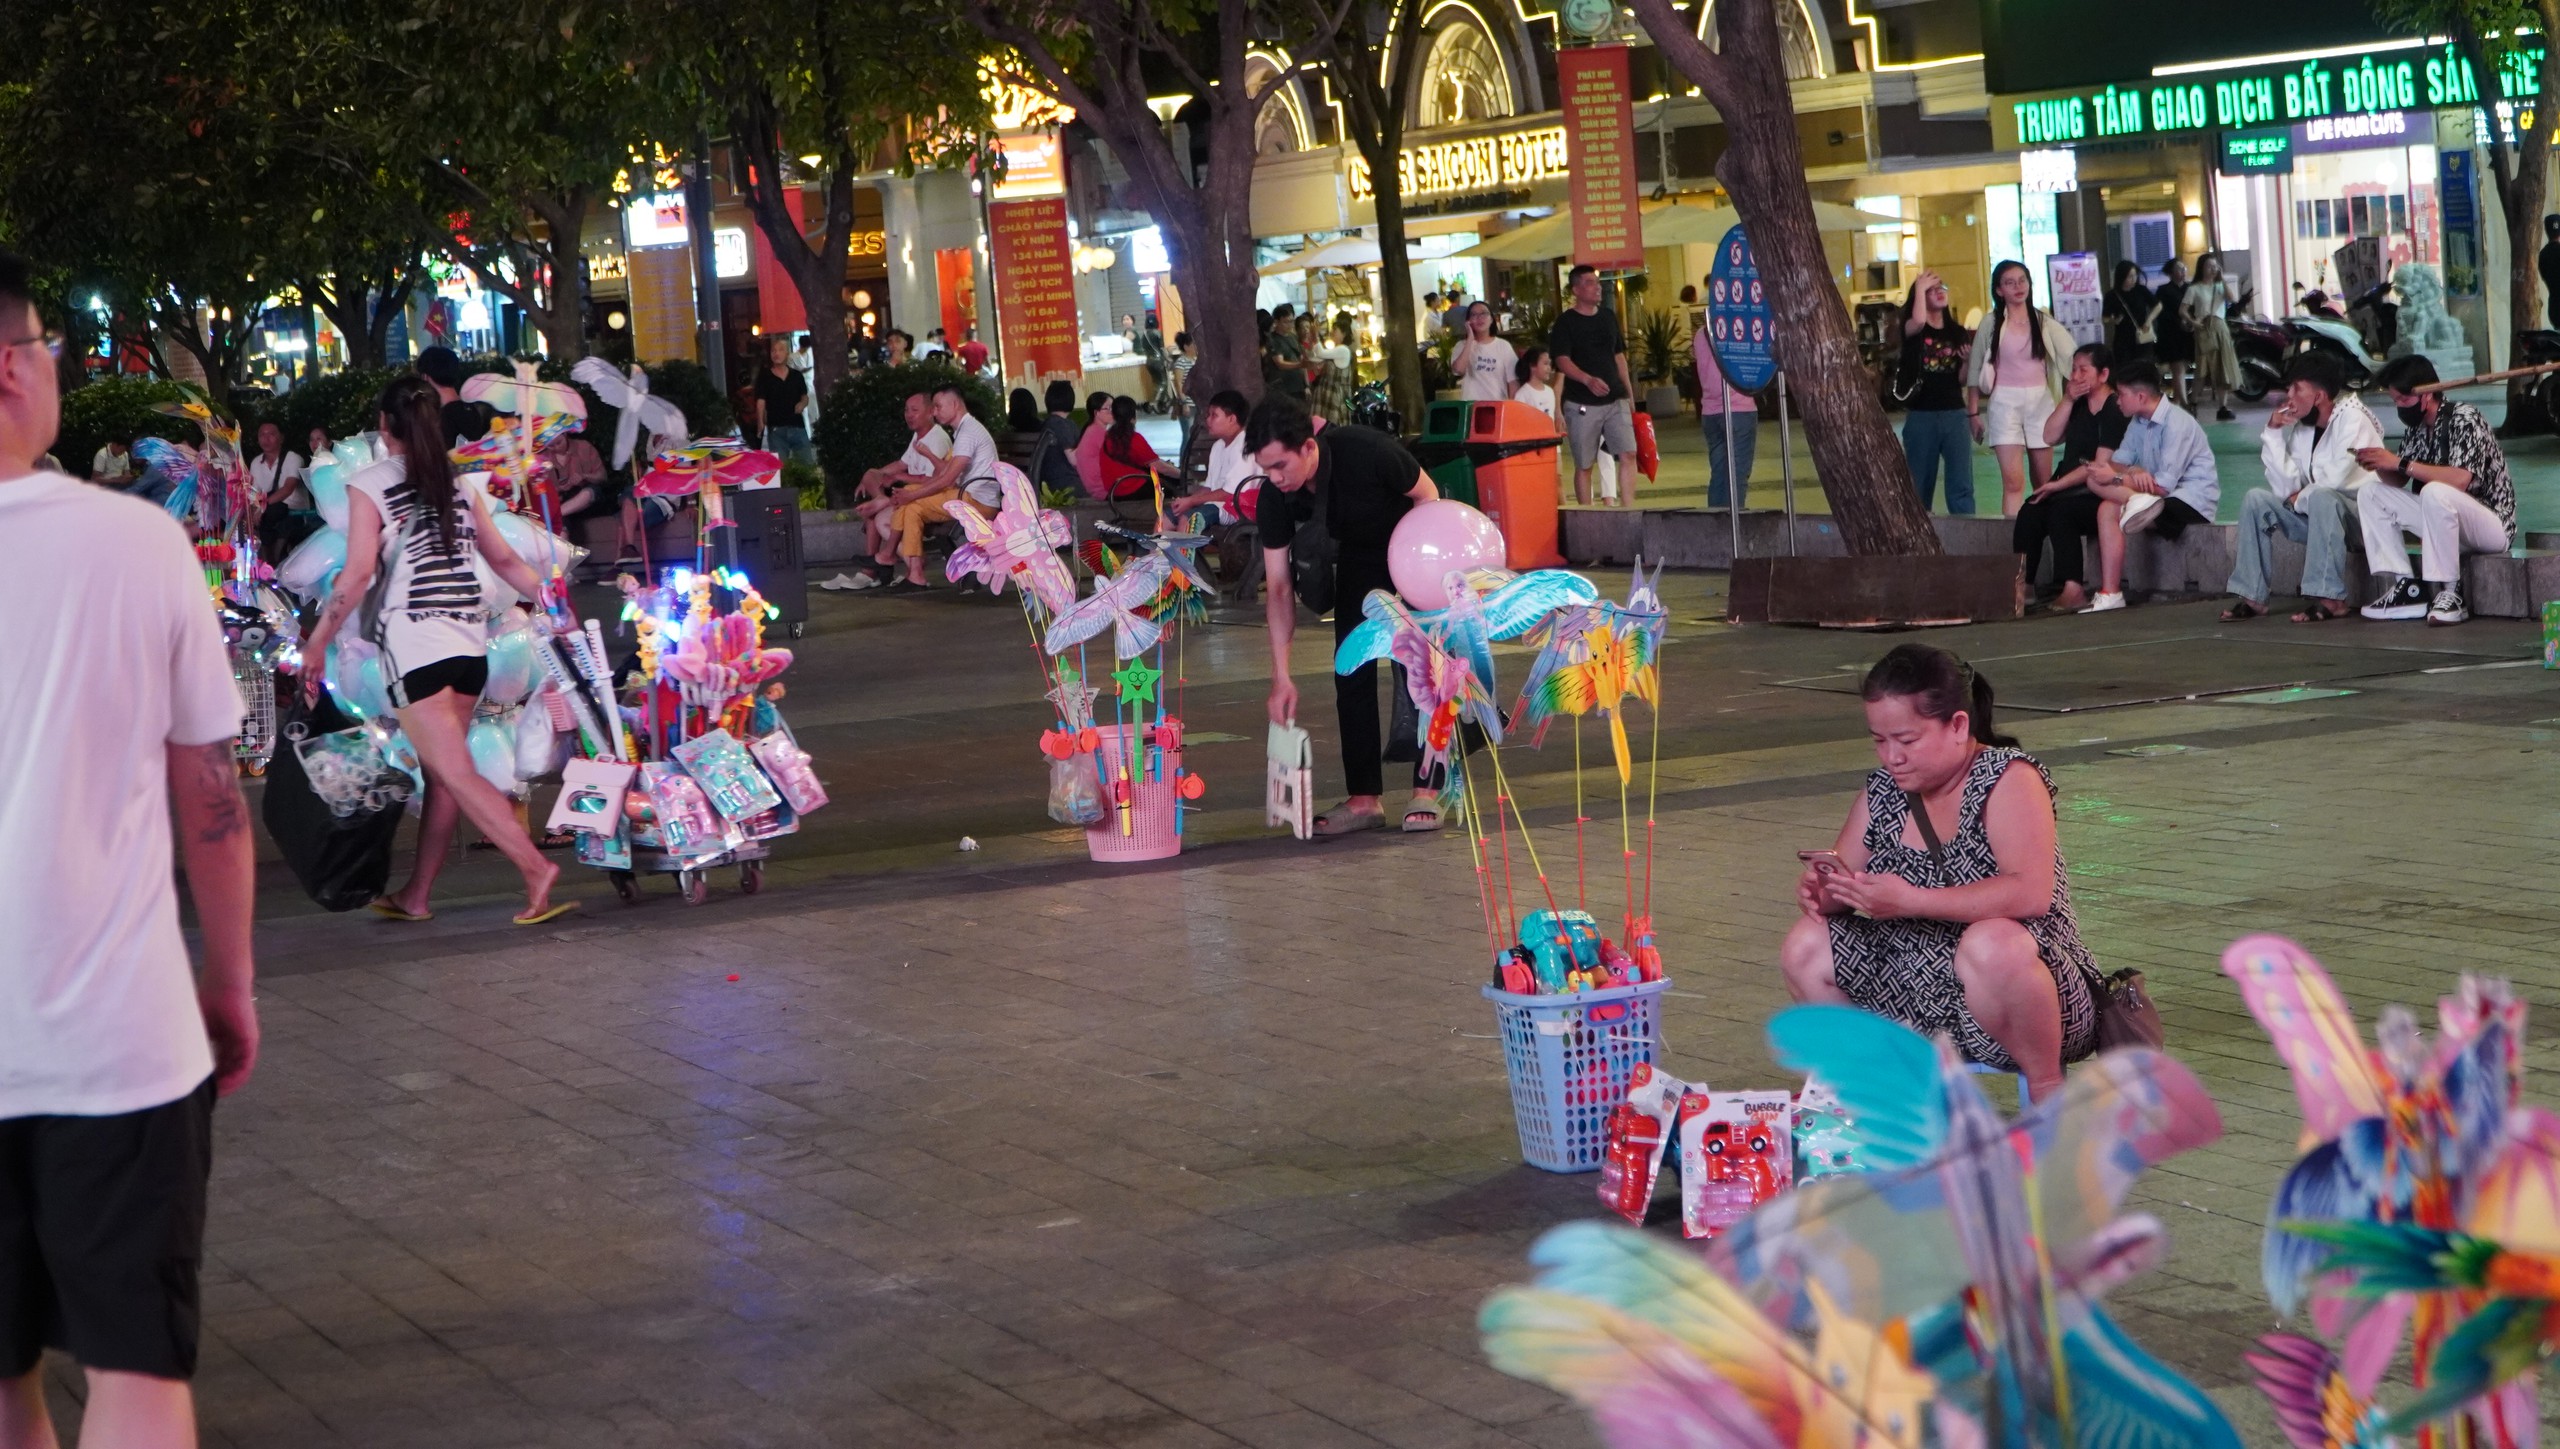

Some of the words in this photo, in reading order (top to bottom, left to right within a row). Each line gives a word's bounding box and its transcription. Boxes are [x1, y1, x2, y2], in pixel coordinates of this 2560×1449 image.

[2014, 96, 2085, 144] TRUNG
[2093, 84, 2142, 136] TÂM
[2151, 85, 2206, 130] GIAO
[2216, 77, 2274, 129] DỊCH
[2284, 59, 2331, 118] BẤT
[2343, 56, 2416, 116] ĐỘNG
[2307, 119, 2334, 141] LIFE
[2334, 115, 2369, 138] FOUR
[2370, 112, 2405, 135] CUTS
[2229, 139, 2258, 154] ZONE
[2259, 137, 2286, 152] GOLF
[1418, 137, 1499, 194] SAIGON
[1500, 126, 1569, 183] HOTEL
[1005, 207, 1035, 218] NHIỆT
[1038, 206, 1055, 216] LIỆT
[998, 222, 1031, 233] CHÀO
[1034, 220, 1064, 230] MỪNG
[1030, 235, 1054, 245] NIỆM
[1013, 252, 1031, 261] 134
[1034, 250, 1057, 258] NĂM
[1007, 265, 1038, 276] NGÀY
[1042, 263, 1064, 272] SINH
[2055, 269, 2096, 283] DREAM
[1013, 279, 1036, 290] CHỦ
[1040, 278, 1062, 288] TỊCH
[2062, 281, 2096, 292] WEEK
[1024, 292, 1044, 303] CHÍ
[1047, 291, 1072, 301] MINH
[1014, 335, 1072, 347] 19/5/2024)
[1744, 1102, 1786, 1115] BUBBLE
